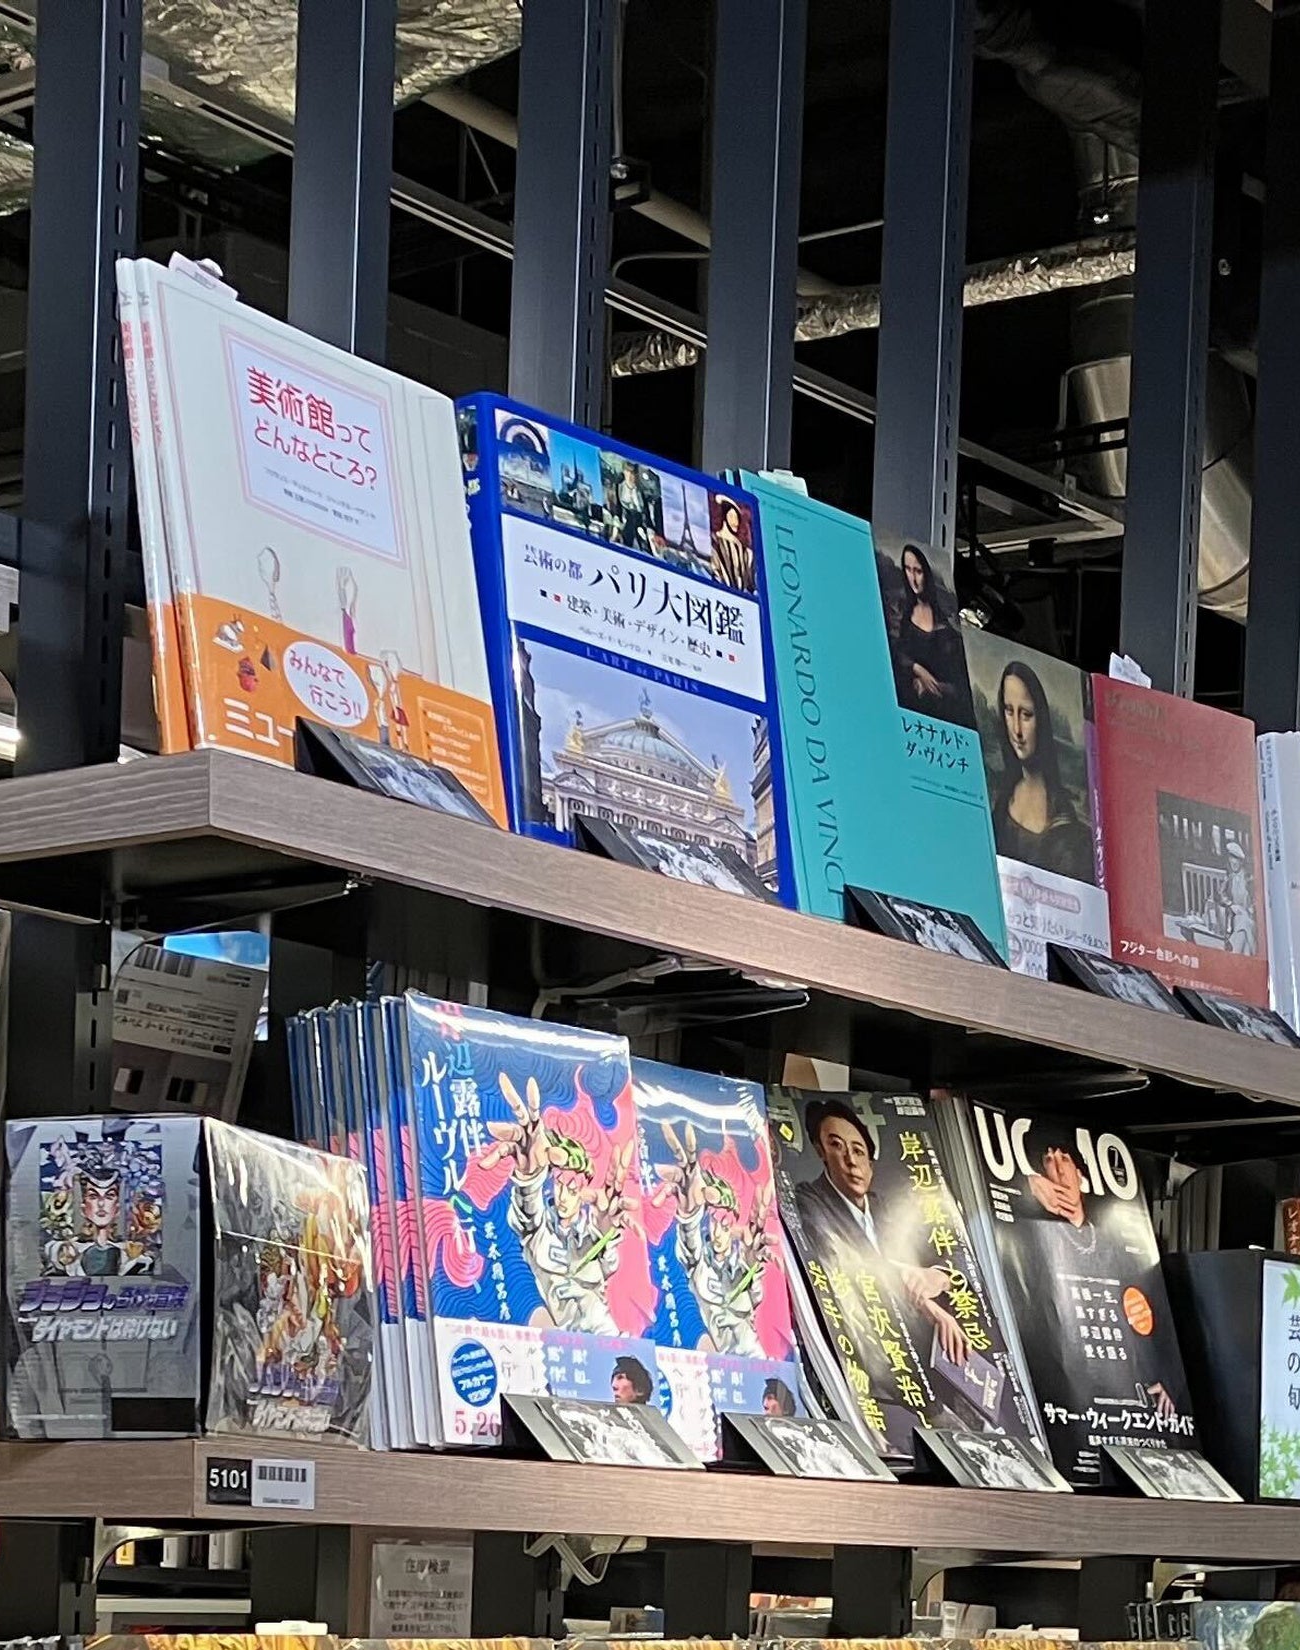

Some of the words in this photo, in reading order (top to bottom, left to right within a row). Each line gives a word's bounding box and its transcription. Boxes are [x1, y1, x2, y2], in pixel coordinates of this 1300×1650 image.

[246, 366, 372, 454] 美術館って
[253, 420, 378, 492] どんなところ?
[589, 562, 746, 646] パリ大図鑑
[774, 522, 822, 740] LEONARDO
[287, 647, 346, 689] みんなで
[808, 737, 831, 786] DA
[905, 739, 971, 775] ダ・ヴィンチ
[814, 796, 847, 897] VINCI
[208, 1468, 249, 1490] 5101
